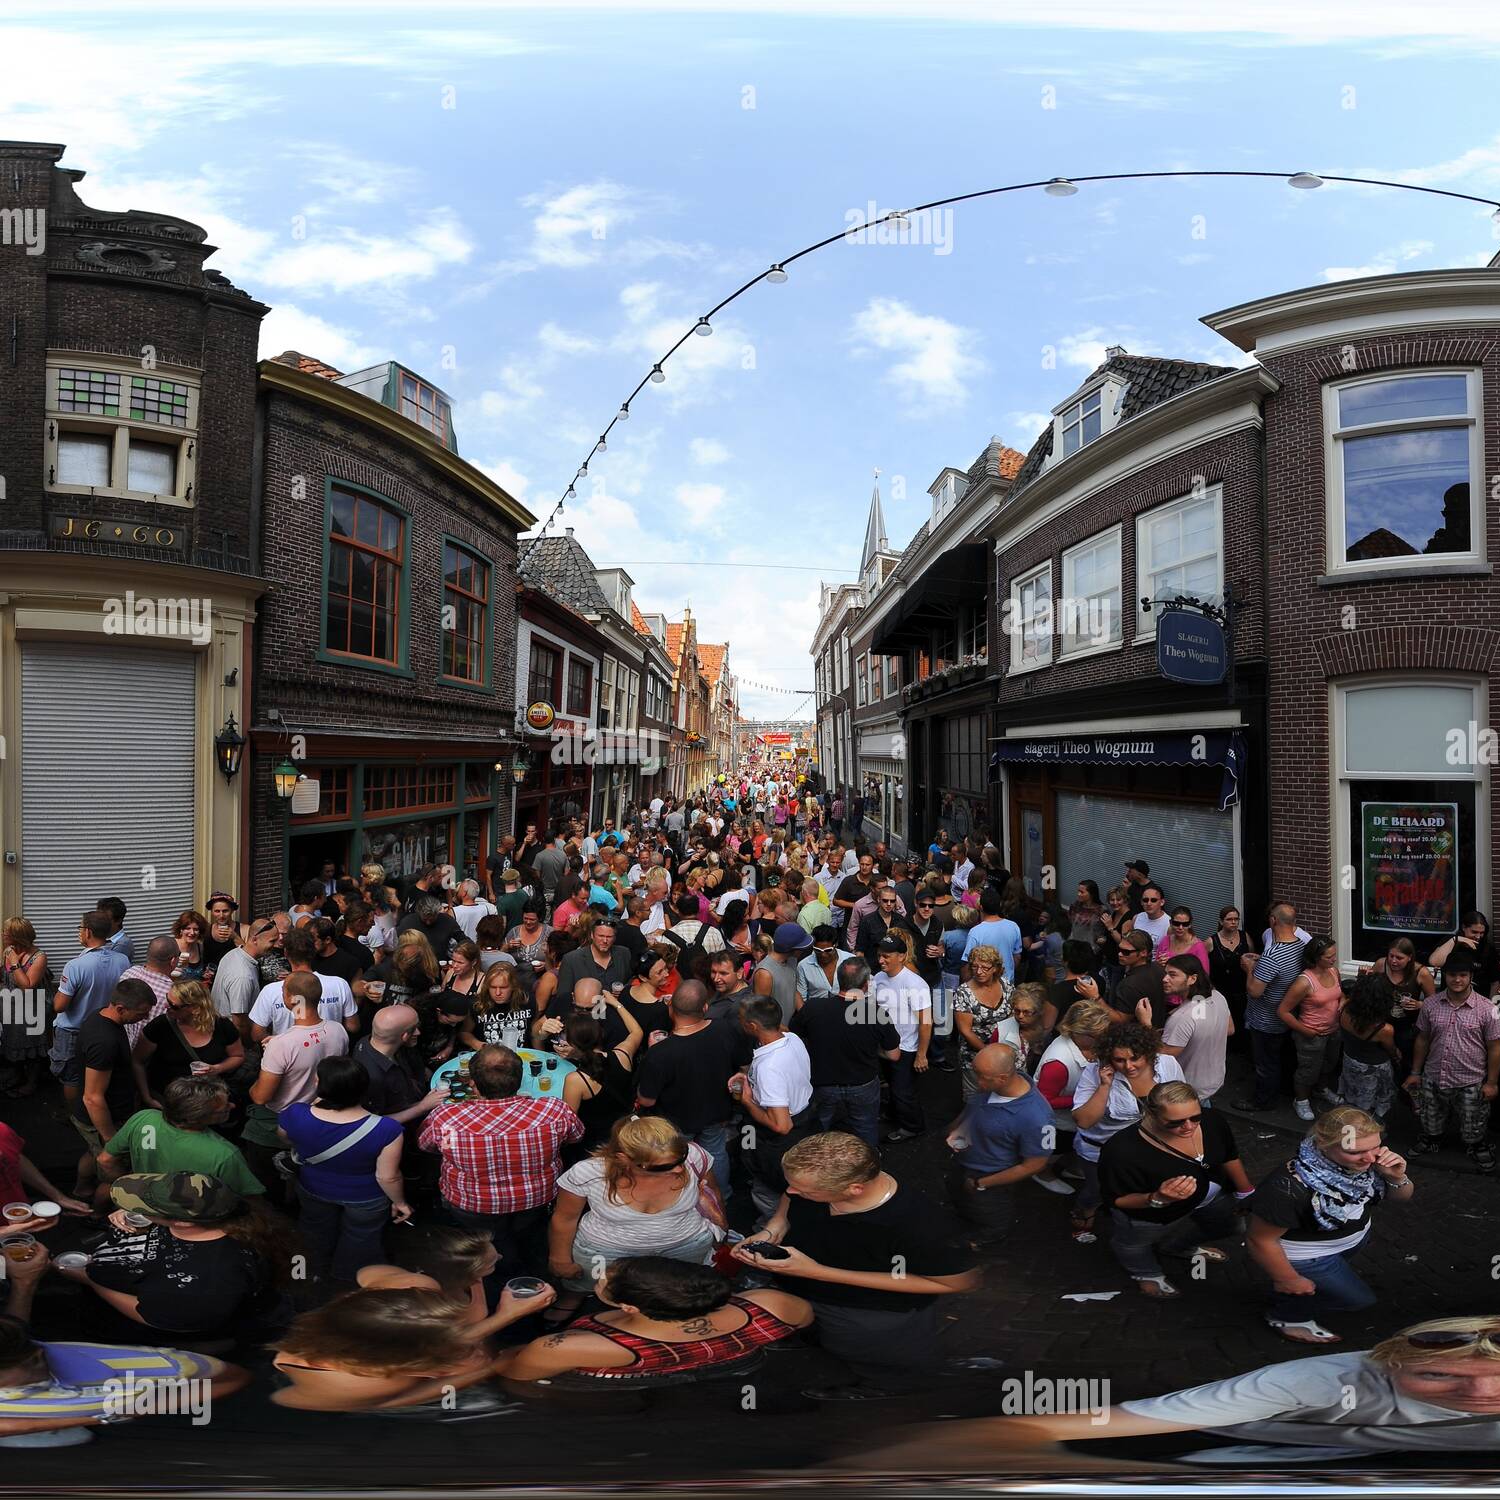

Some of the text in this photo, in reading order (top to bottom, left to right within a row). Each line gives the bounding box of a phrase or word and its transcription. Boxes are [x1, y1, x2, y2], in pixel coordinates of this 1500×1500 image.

[1178, 632, 1209, 646] SLAGERIJ
[1164, 644, 1219, 664] Theo Wognum
[1025, 739, 1155, 758] slagerij Theo Wognum
[1373, 816, 1446, 827] DE BEIAARD
[477, 1008, 532, 1024] MACABRE
[147, 1239, 160, 1261] HEAD
